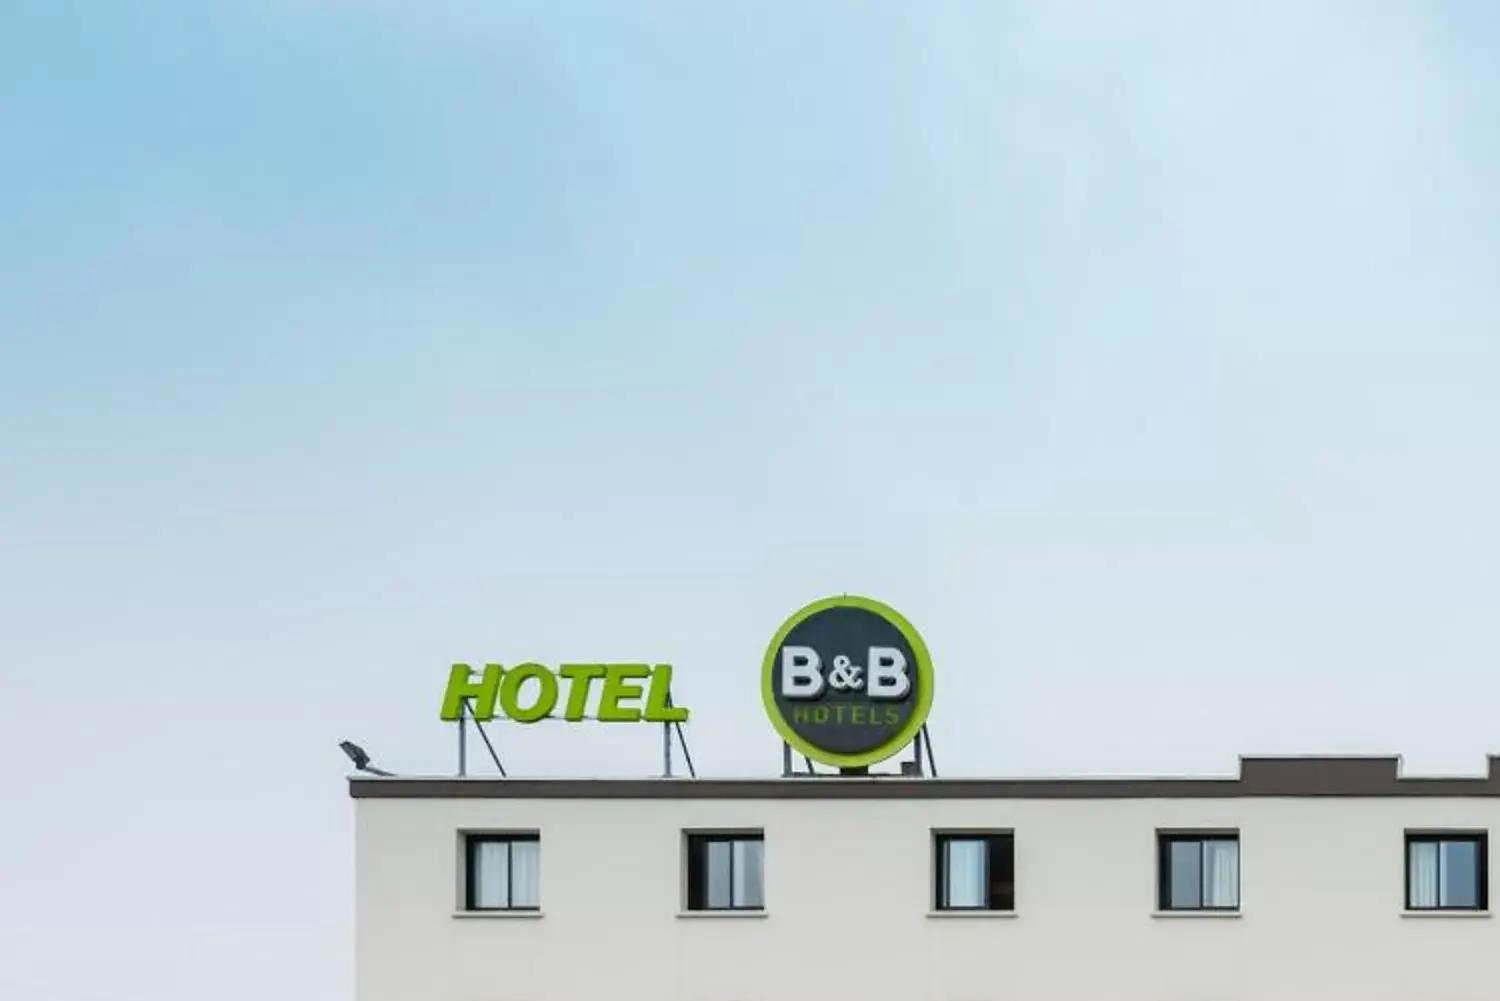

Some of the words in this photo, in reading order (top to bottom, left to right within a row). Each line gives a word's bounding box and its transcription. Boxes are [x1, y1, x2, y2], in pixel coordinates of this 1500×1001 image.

[440, 662, 689, 723] HOTEL
[781, 645, 912, 699] B&B
[793, 704, 901, 726] HOTELS
